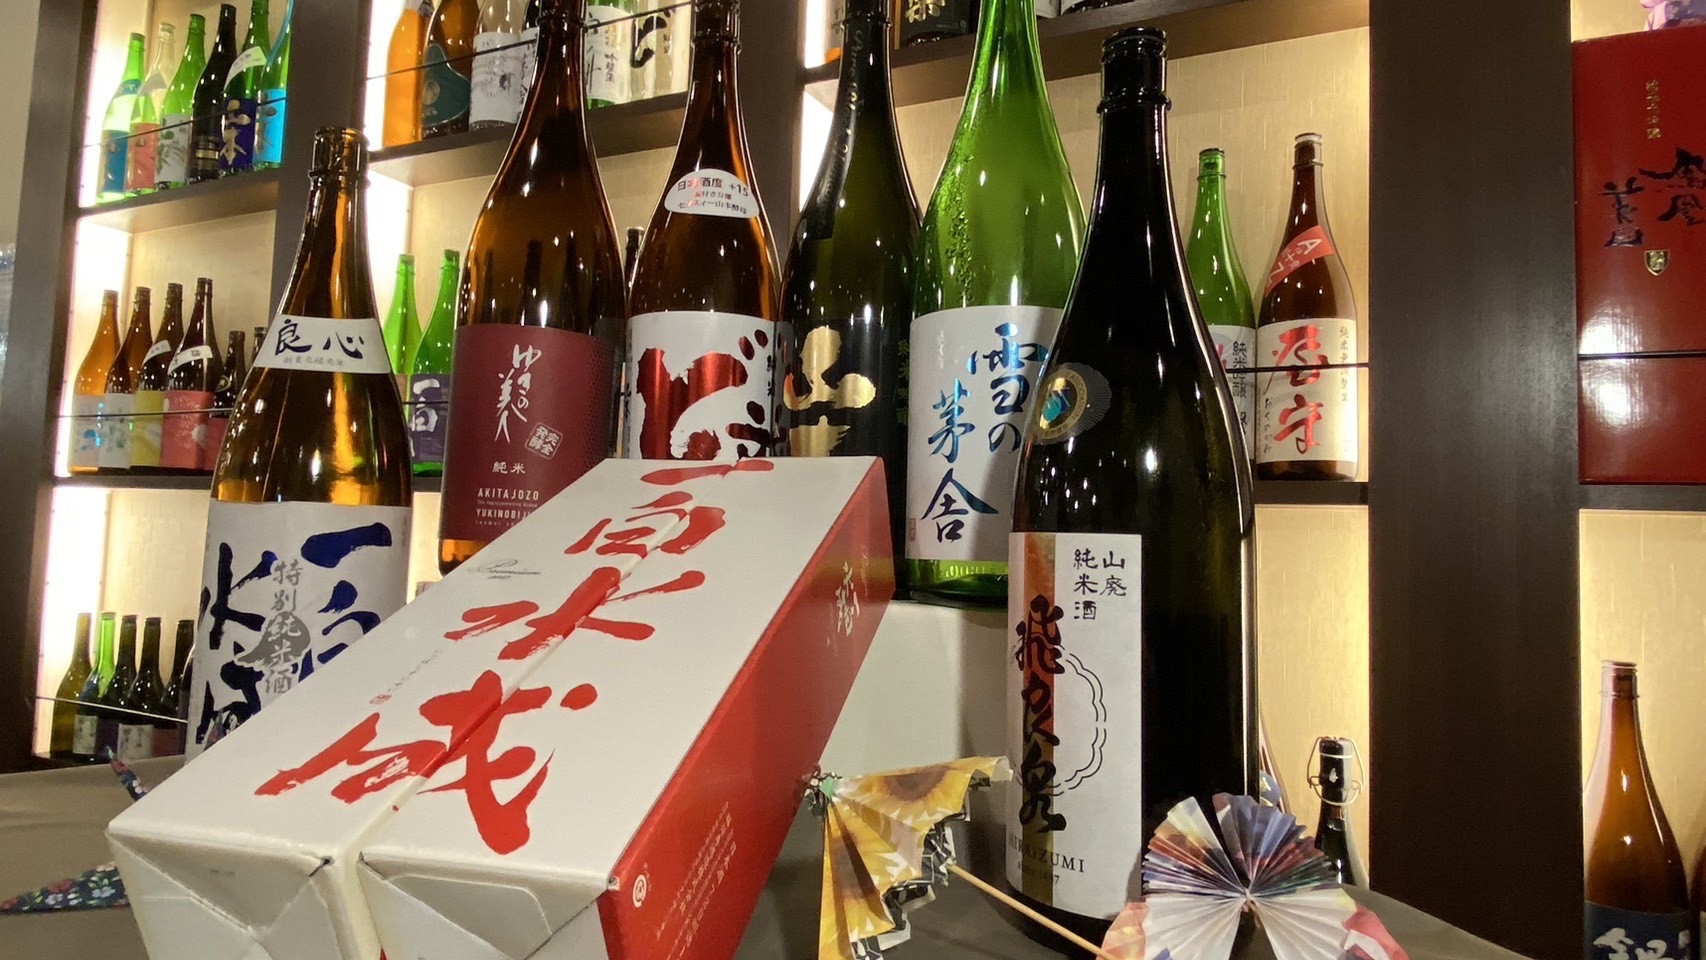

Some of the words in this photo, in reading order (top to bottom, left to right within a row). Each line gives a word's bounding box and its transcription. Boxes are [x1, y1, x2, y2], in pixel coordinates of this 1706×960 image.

[729, 183, 749, 197] +15
[275, 319, 364, 359] 良心
[495, 368, 527, 444] 美人
[513, 344, 542, 409] ゆきの
[967, 322, 1049, 452] 雪の
[492, 461, 526, 475] 純米
[921, 378, 999, 543] 茅舎
[477, 487, 539, 501] AKITAJOZO
[1073, 548, 1099, 621] 純米酒
[1100, 550, 1127, 598] 山廃
[265, 558, 303, 694] 特別純米酒
